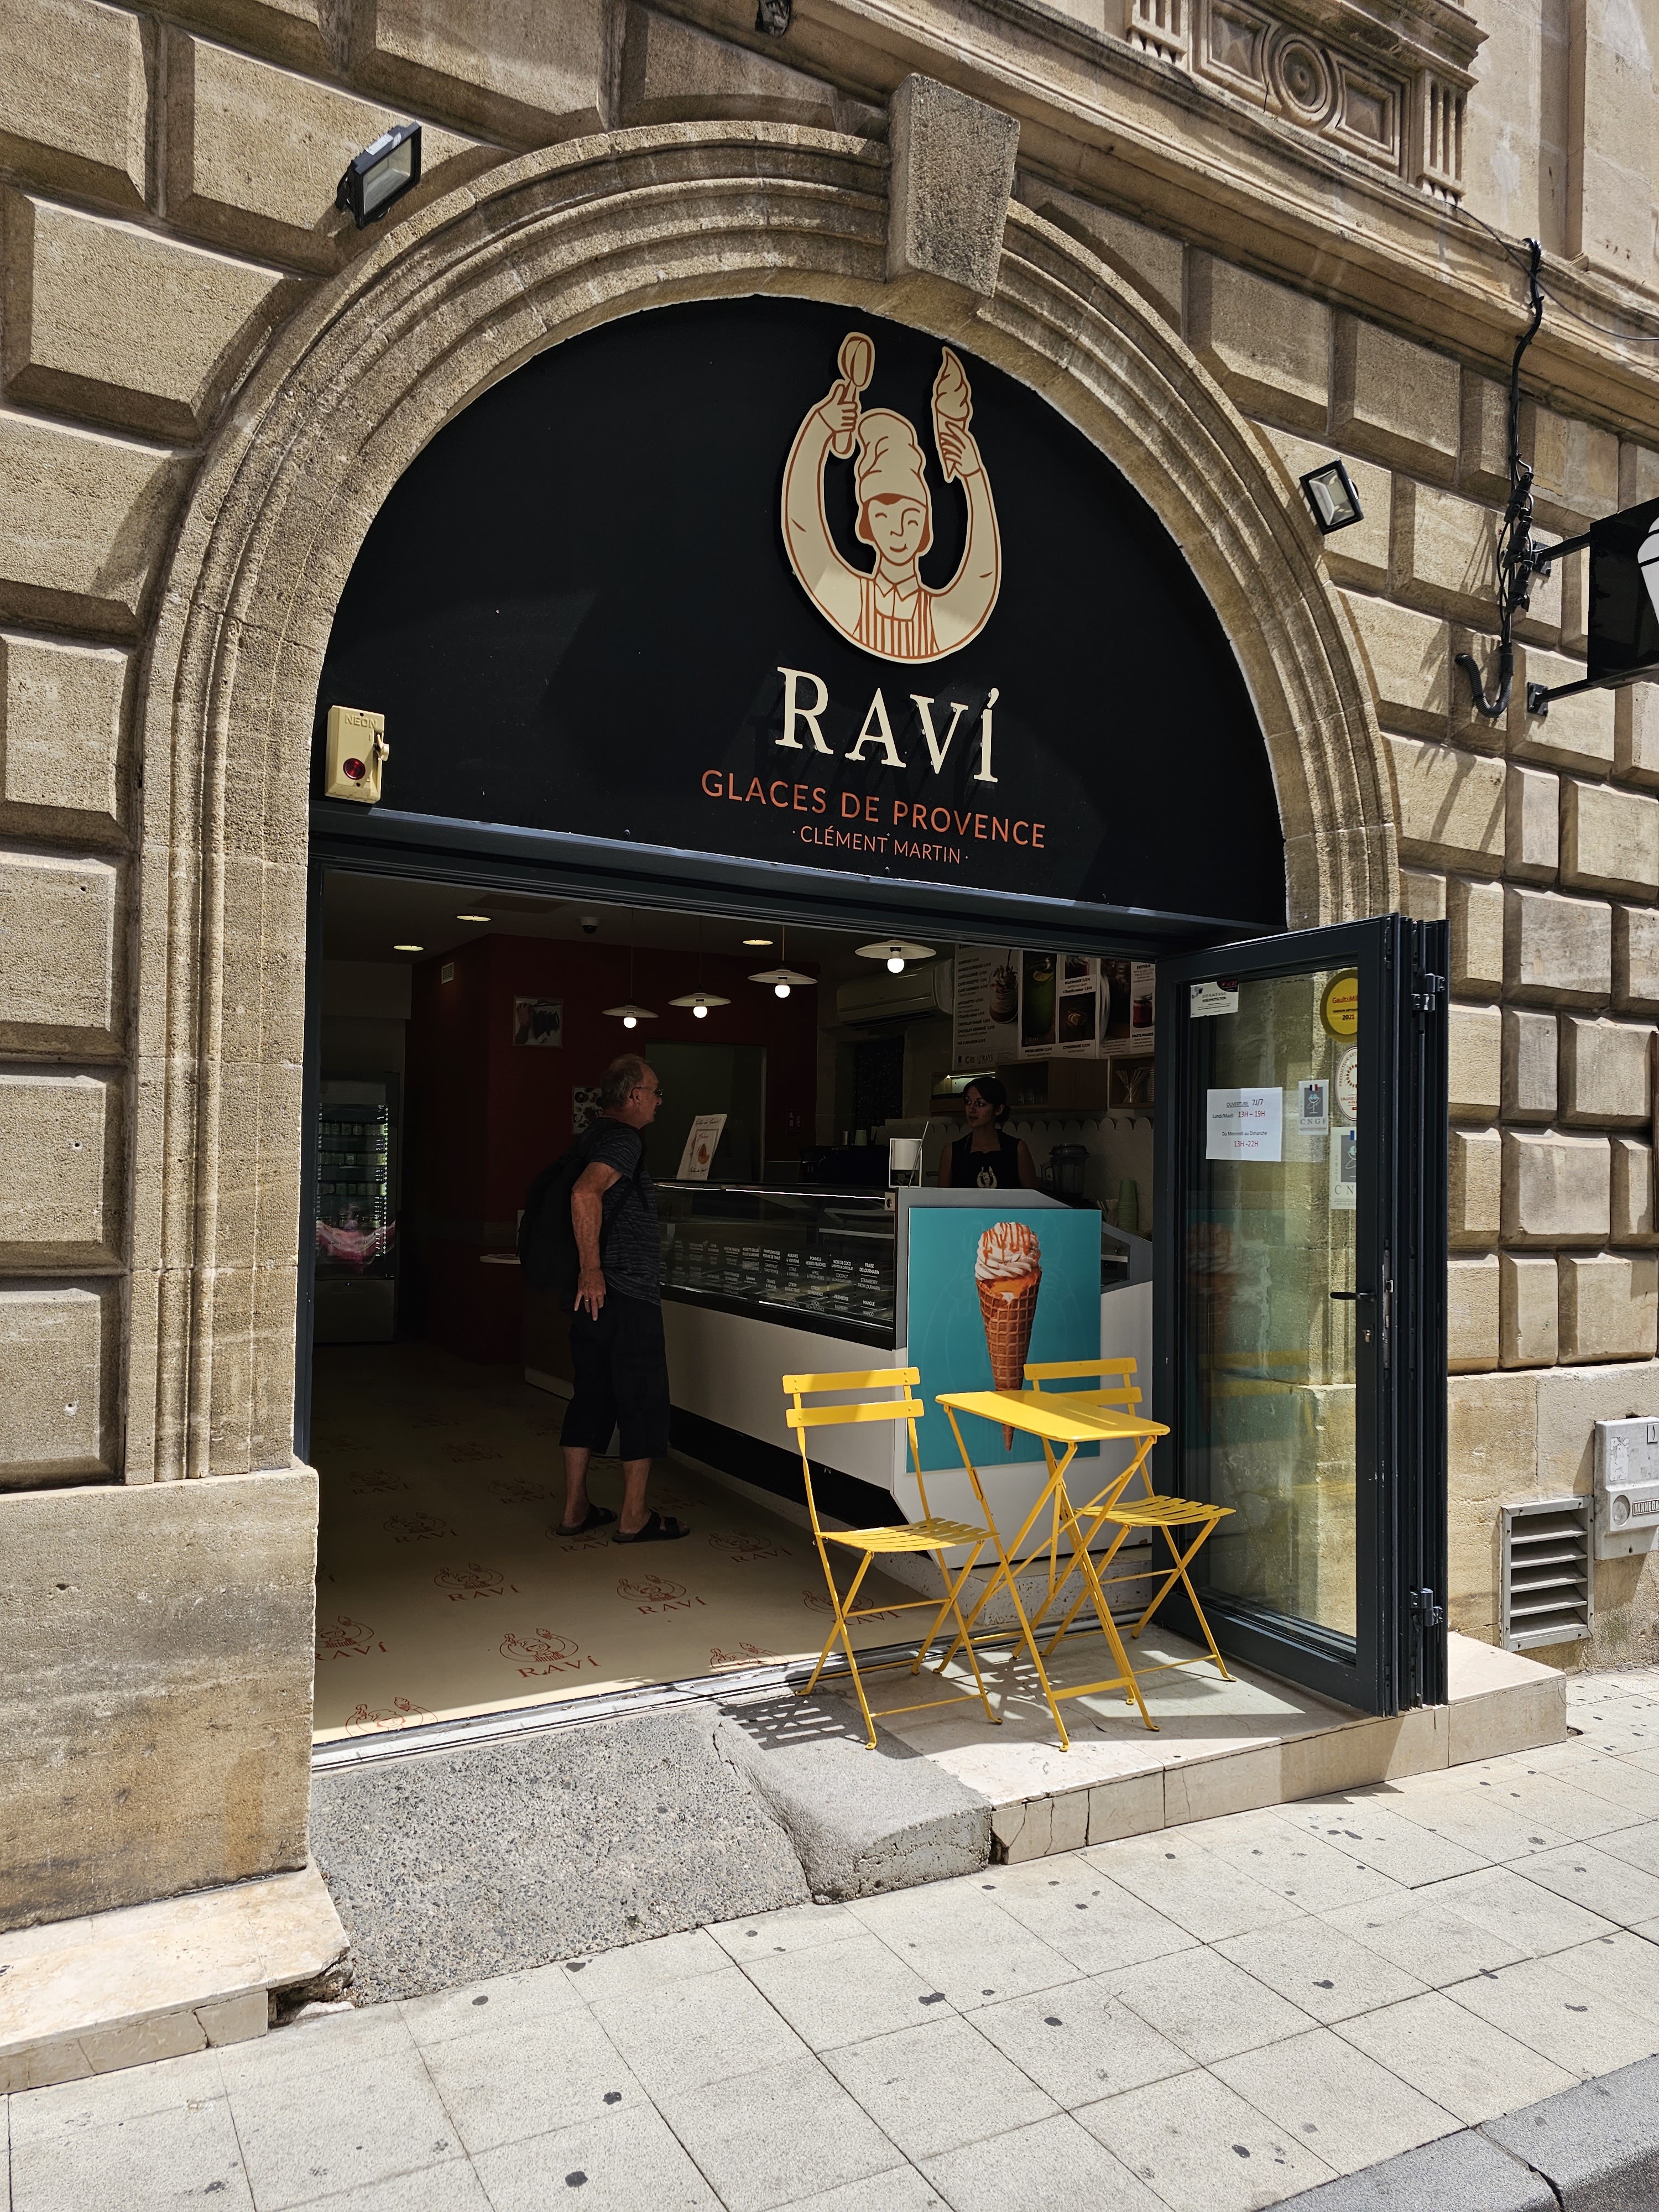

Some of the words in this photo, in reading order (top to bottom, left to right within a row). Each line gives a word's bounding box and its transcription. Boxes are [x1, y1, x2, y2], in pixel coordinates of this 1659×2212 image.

[345, 714, 377, 729] NEON
[775, 666, 999, 782] RAVÍ
[701, 769, 826, 813] GLACES
[841, 792, 879, 823] DE
[894, 801, 1045, 848] PROVENCE
[801, 826, 888, 853] CLÉMENT
[894, 839, 961, 864] MARTIN
[1634, 1502, 1651, 1514] VANNE
[560, 1541, 609, 1552] RAV
